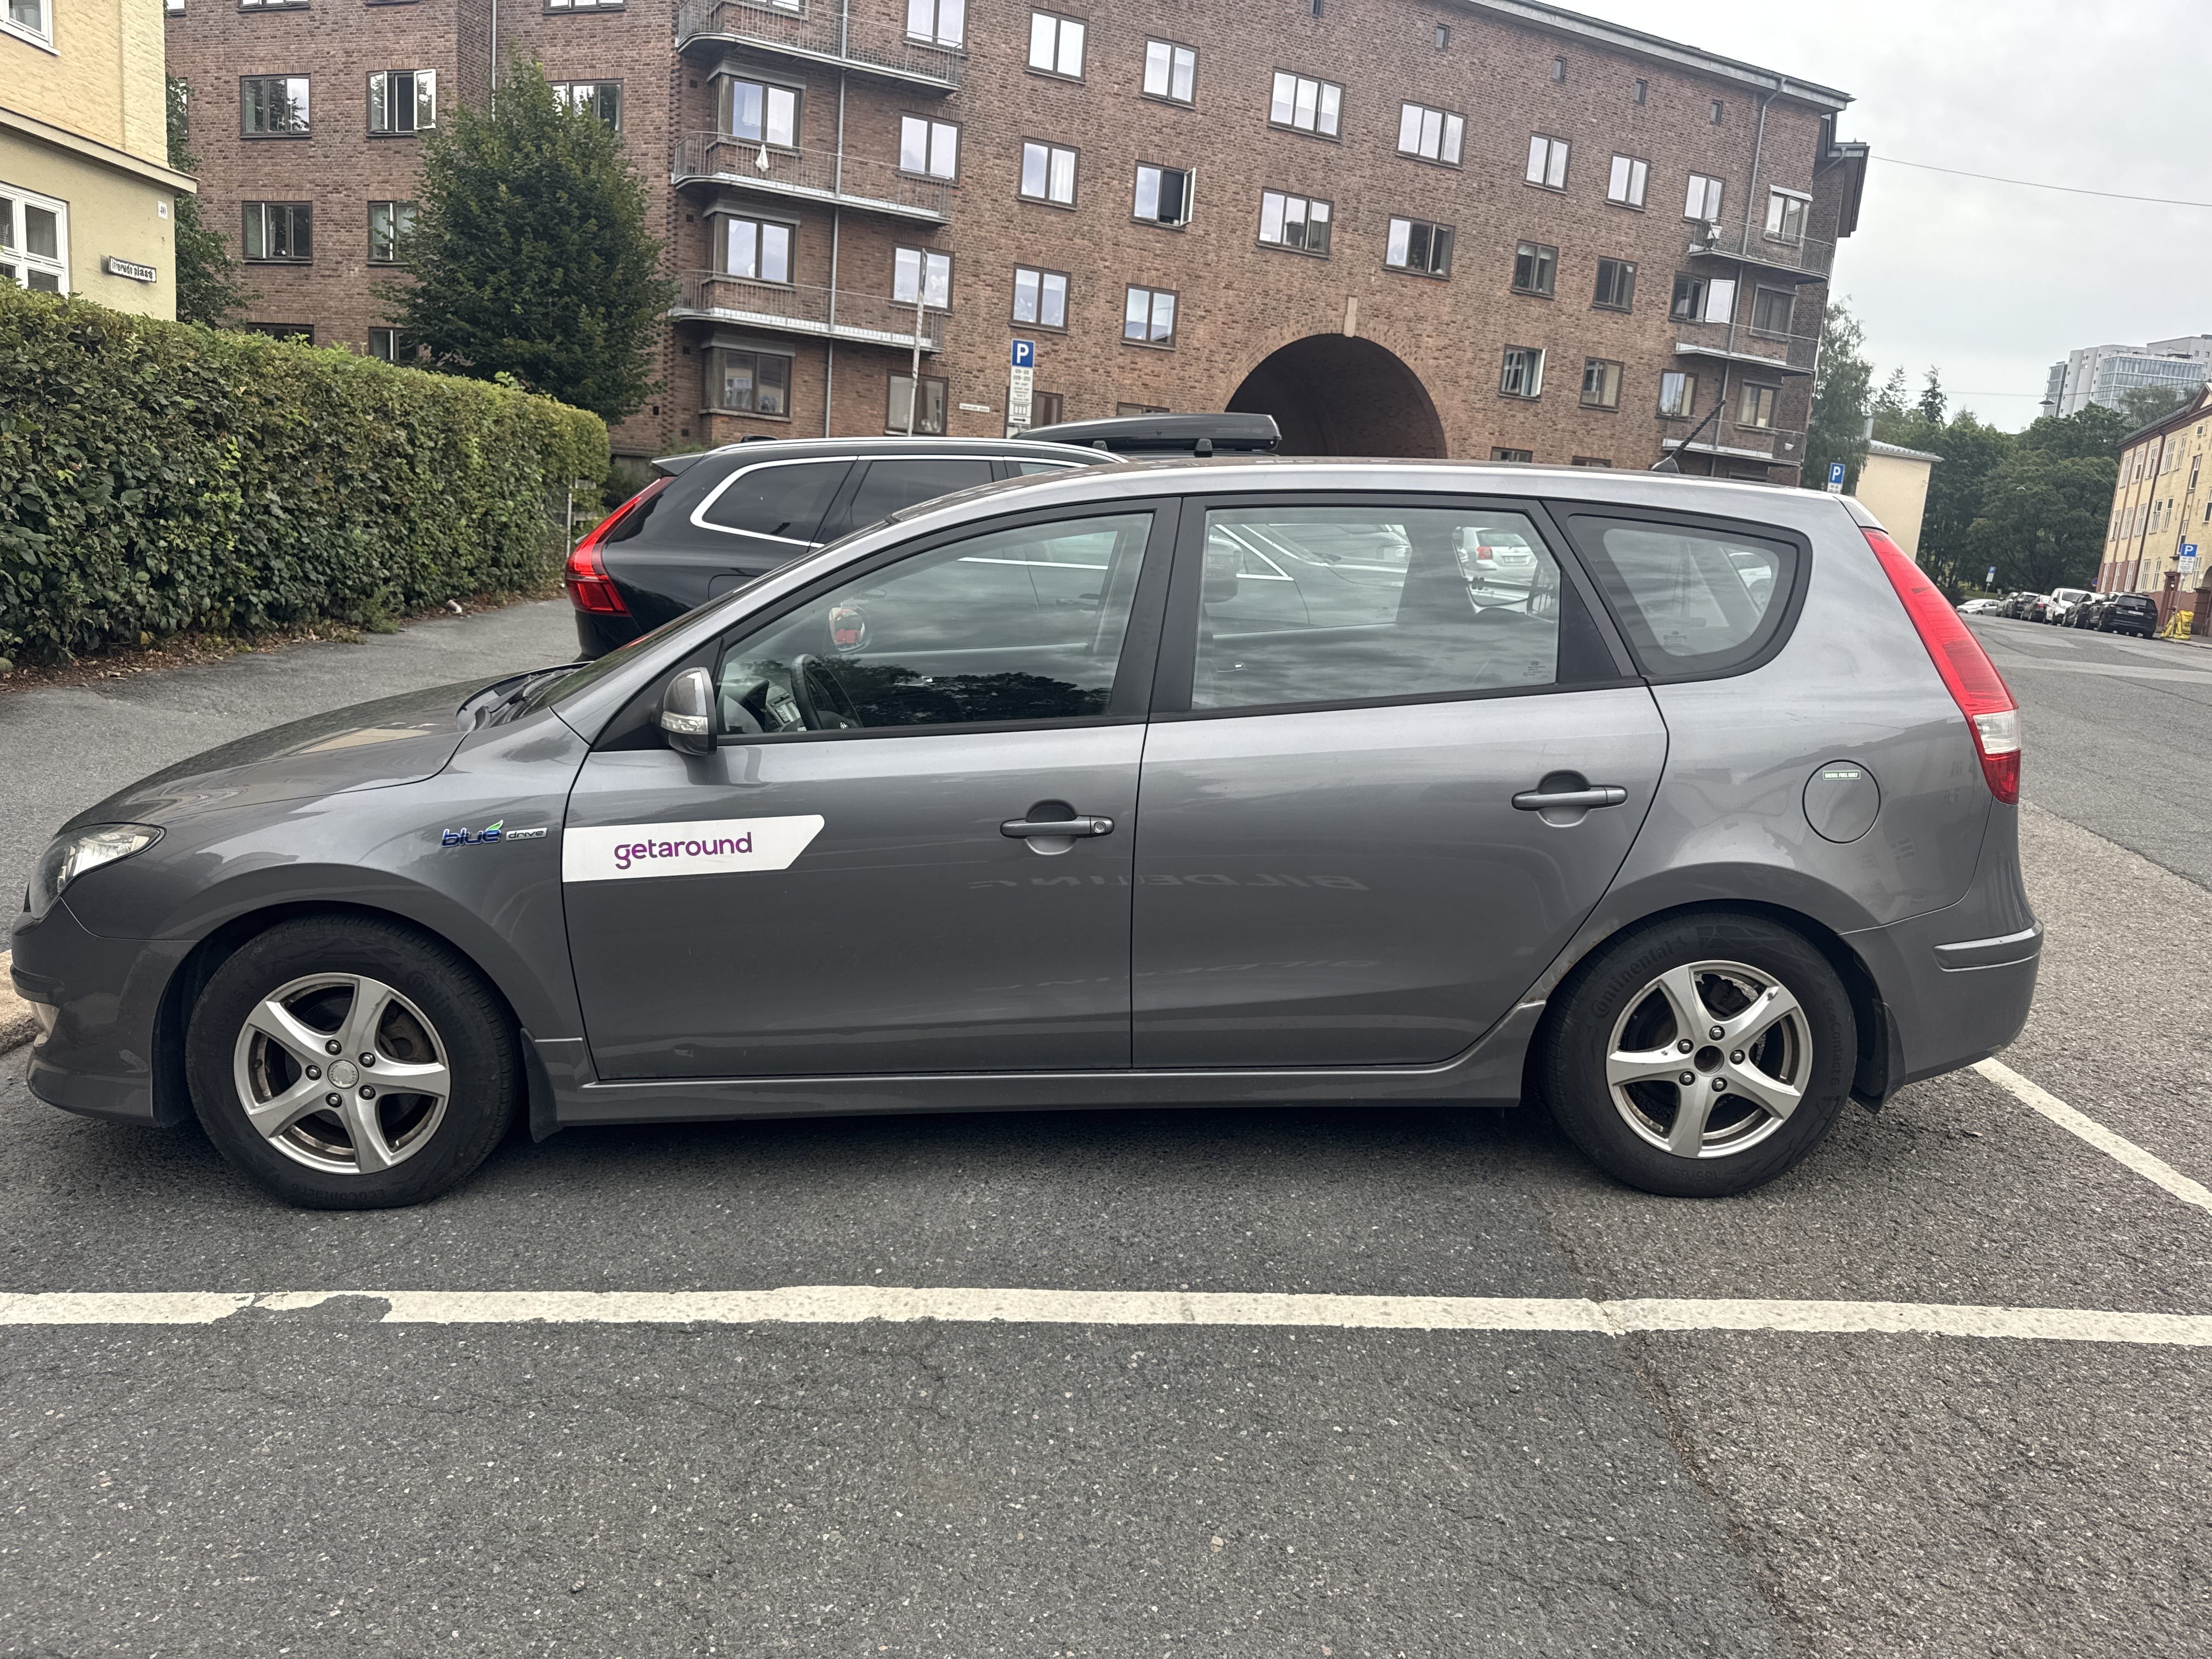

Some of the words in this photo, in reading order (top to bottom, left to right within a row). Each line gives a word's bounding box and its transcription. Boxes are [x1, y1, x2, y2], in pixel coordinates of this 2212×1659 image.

[160, 206, 166, 215] 40
[134, 266, 153, 279] plass
[1017, 343, 1029, 363] P
[1832, 466, 1841, 481] P
[2184, 545, 2194, 555] P
[441, 828, 500, 847] blue
[507, 830, 545, 839] drive
[614, 832, 752, 870] getaround
[1592, 940, 1675, 1020] Continental
[1822, 998, 1844, 1075] EcoContact
[1829, 1077, 1841, 1087] 6
